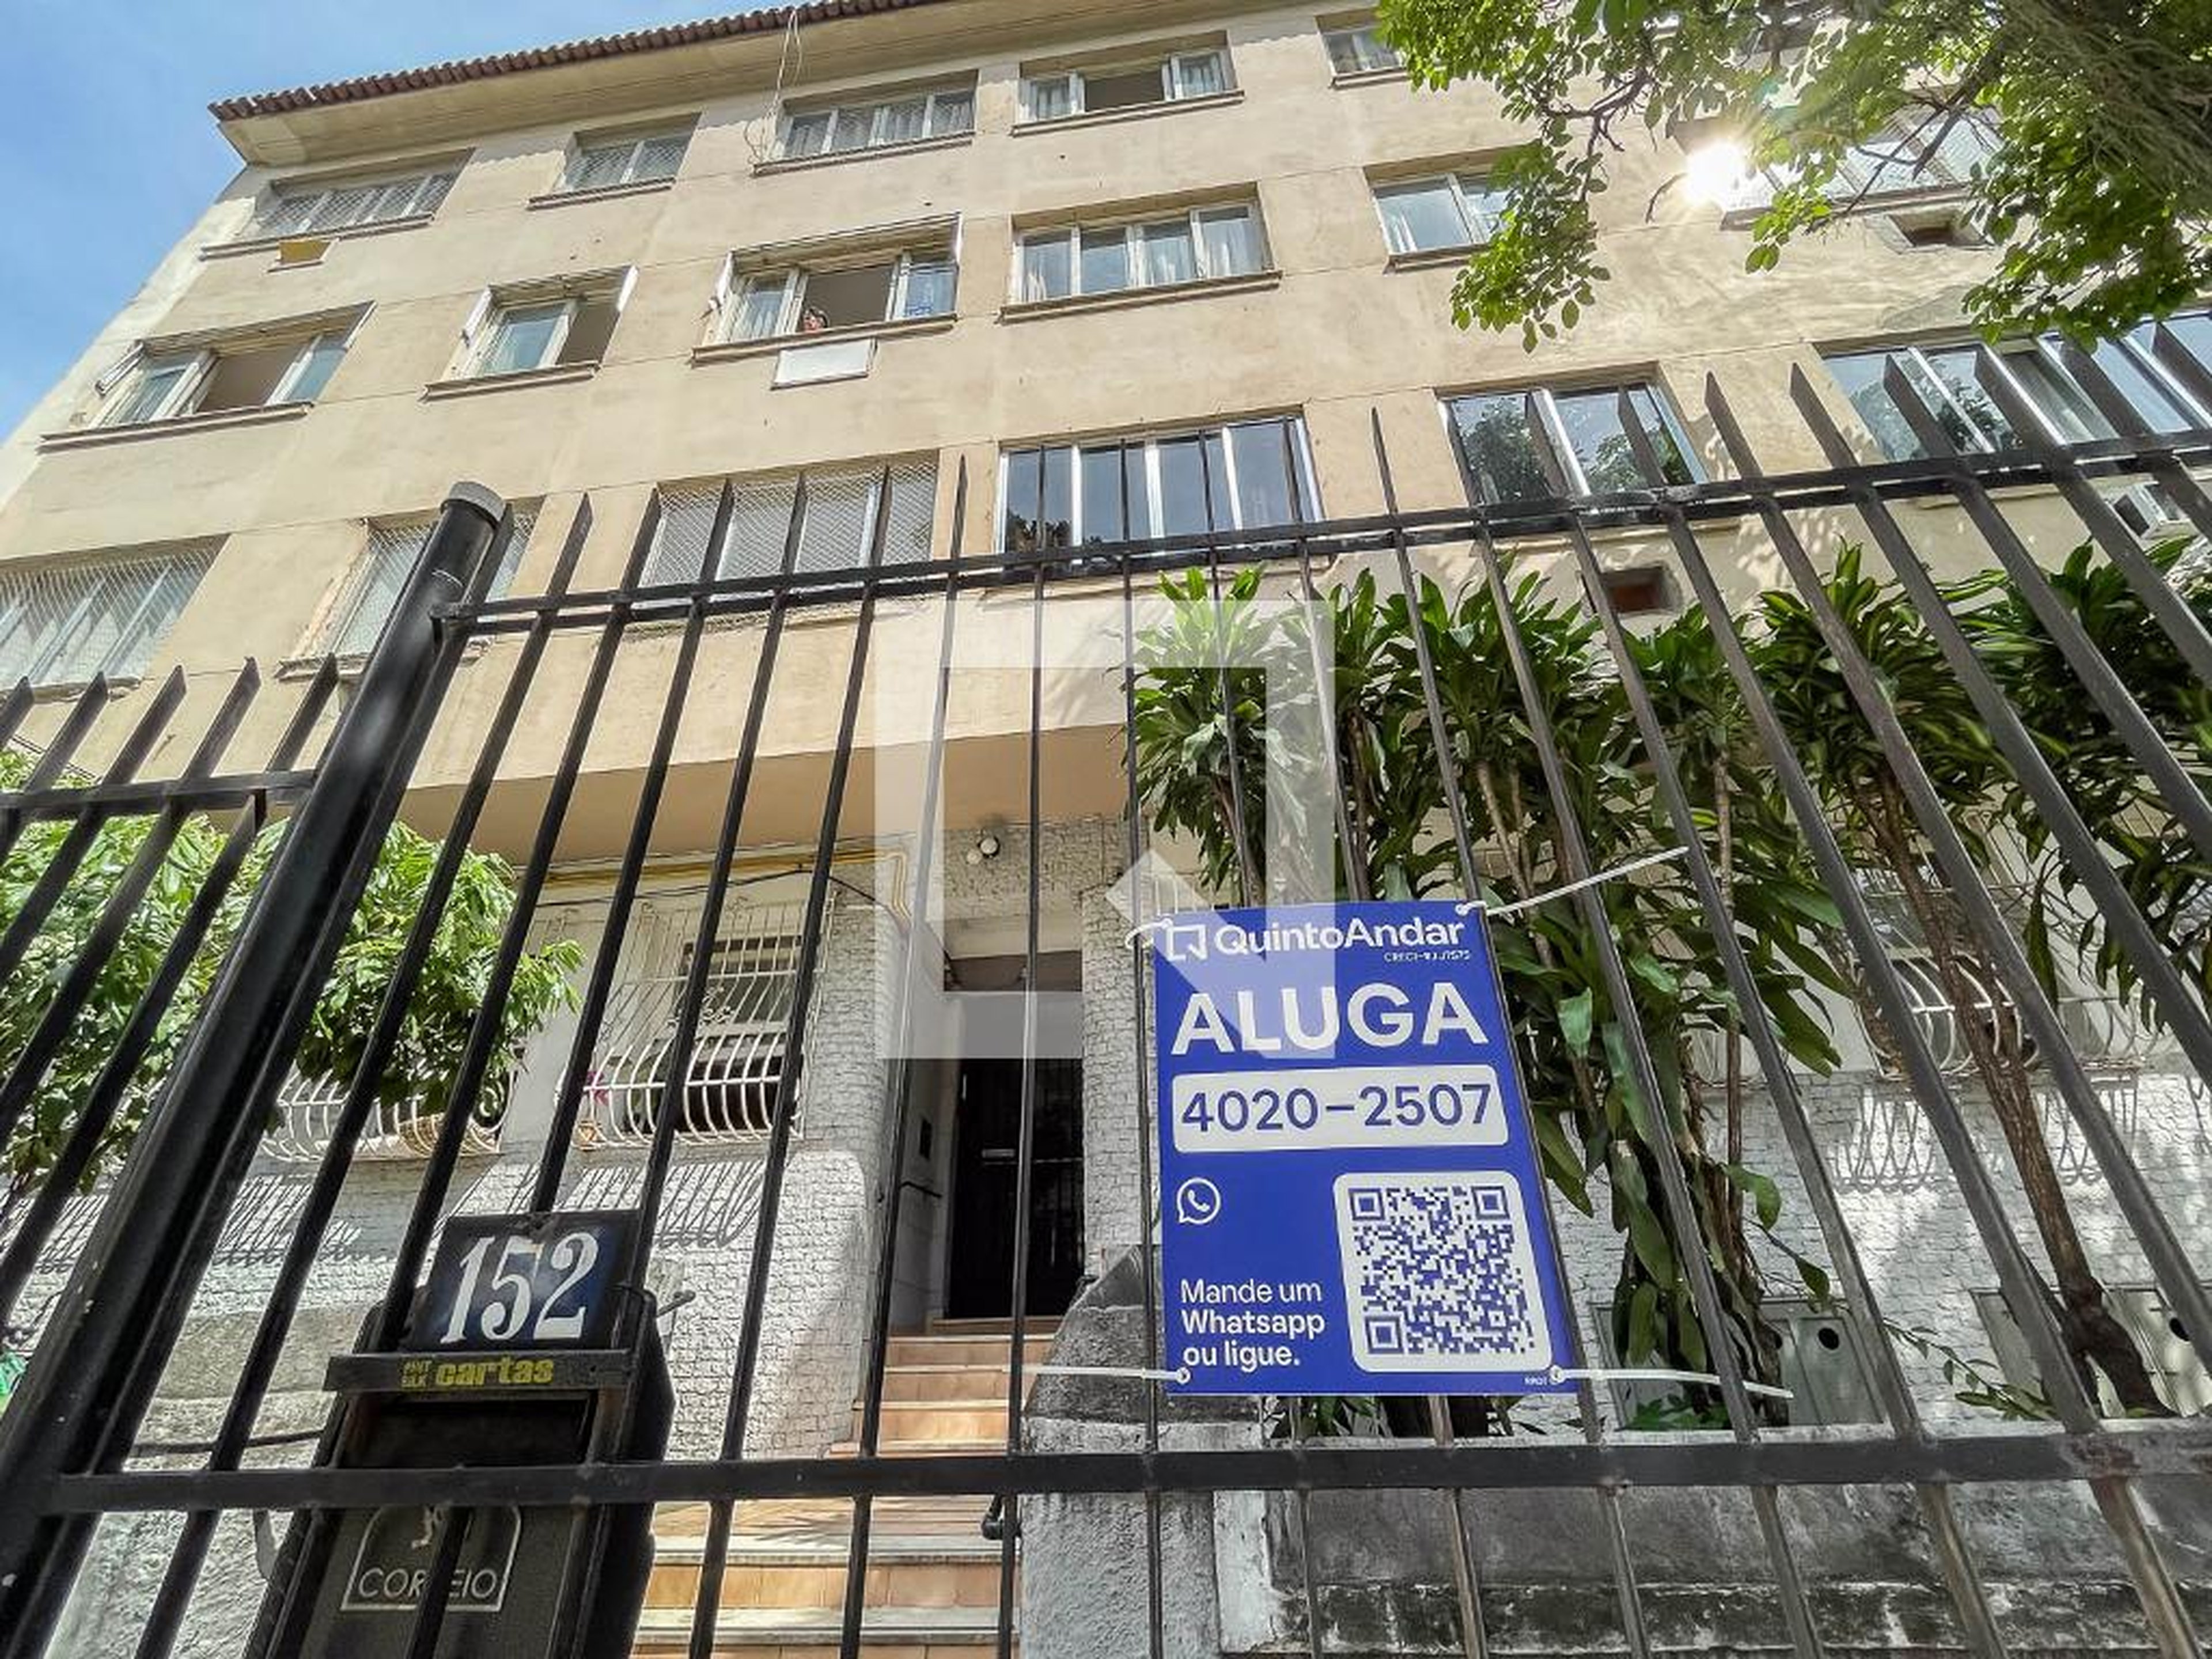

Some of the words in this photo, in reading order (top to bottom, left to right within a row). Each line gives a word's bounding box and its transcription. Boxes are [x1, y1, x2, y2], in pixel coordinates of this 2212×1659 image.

[1214, 917, 1465, 956] QuintoAndar
[1171, 982, 1488, 1055] ALUGA
[1181, 1082, 1492, 1133] 4020-2507
[440, 1232, 599, 1344] 152
[1180, 1278, 1272, 1304] Mande
[1279, 1282, 1322, 1302] um
[1181, 1308, 1325, 1340] Whatsapp
[436, 1355, 554, 1385] cartas
[1183, 1344, 1217, 1366] ou
[1224, 1339, 1301, 1373] ligue.
[358, 1568, 497, 1599] COREIO
